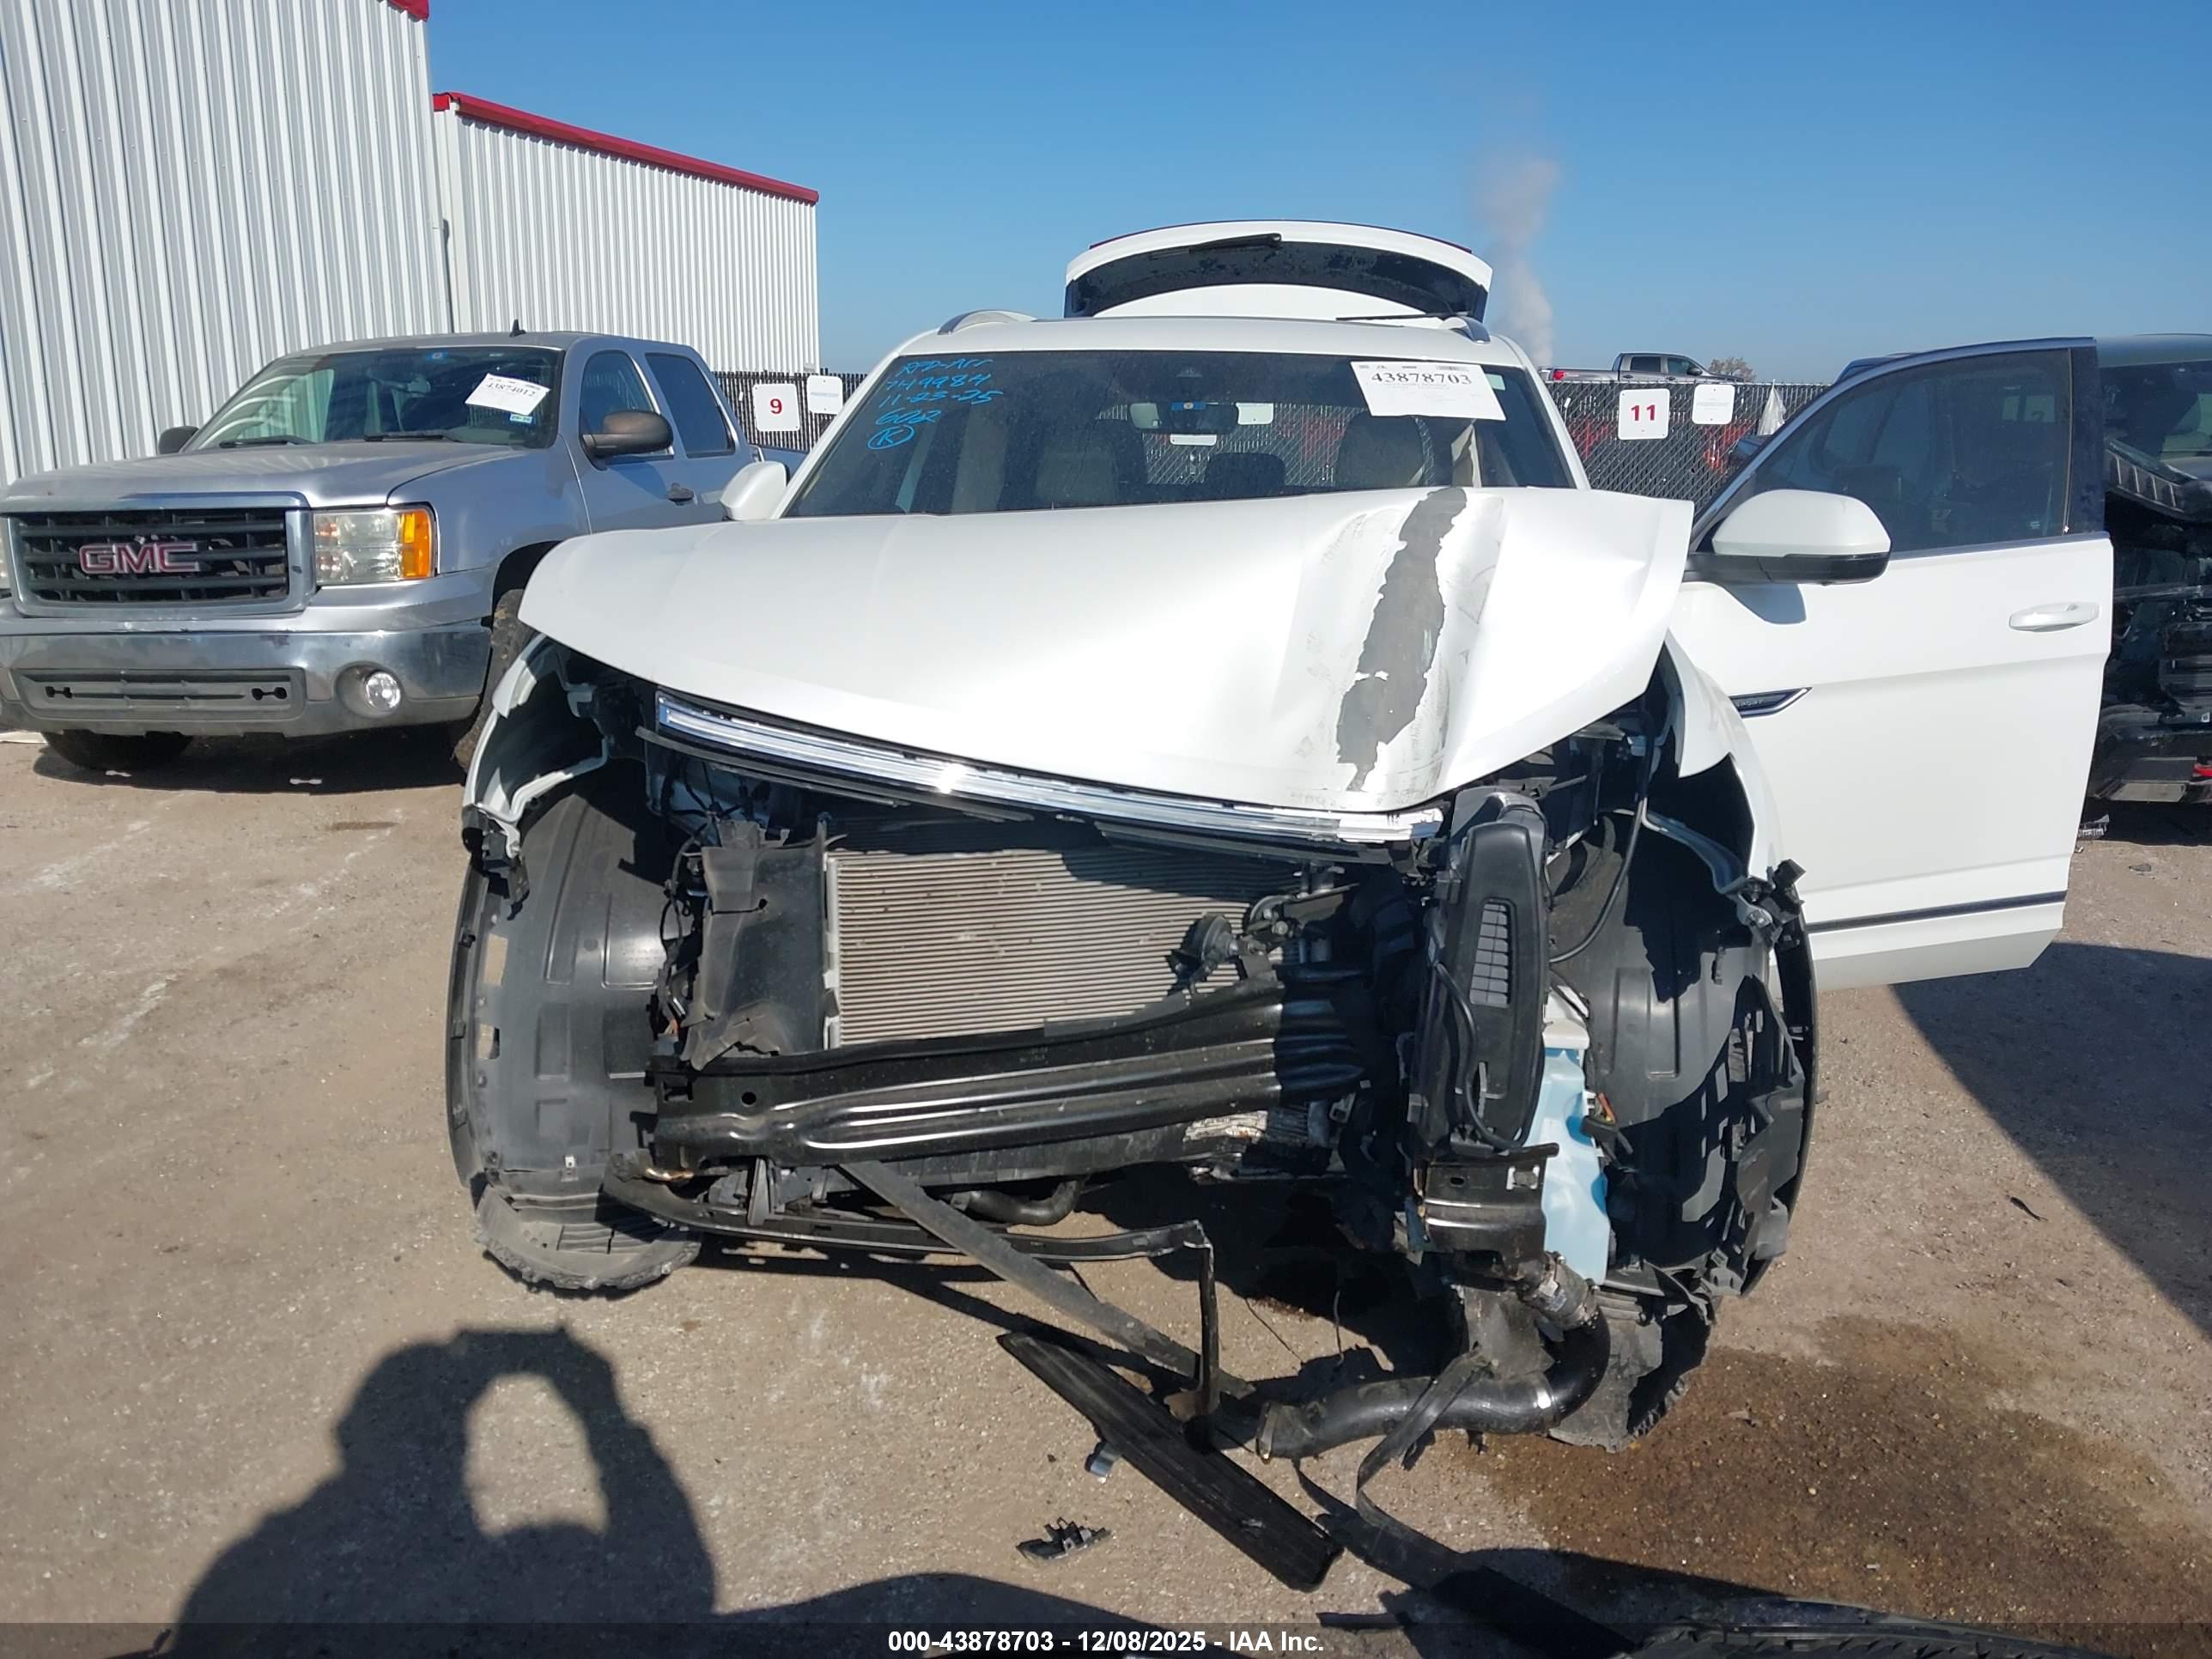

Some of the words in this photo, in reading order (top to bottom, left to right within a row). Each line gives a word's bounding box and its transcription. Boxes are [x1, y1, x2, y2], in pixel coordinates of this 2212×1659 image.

[1371, 372, 1473, 385] 43878703
[769, 398, 783, 415] 9
[1631, 404, 1656, 422] 11
[79, 542, 200, 574] GMC
